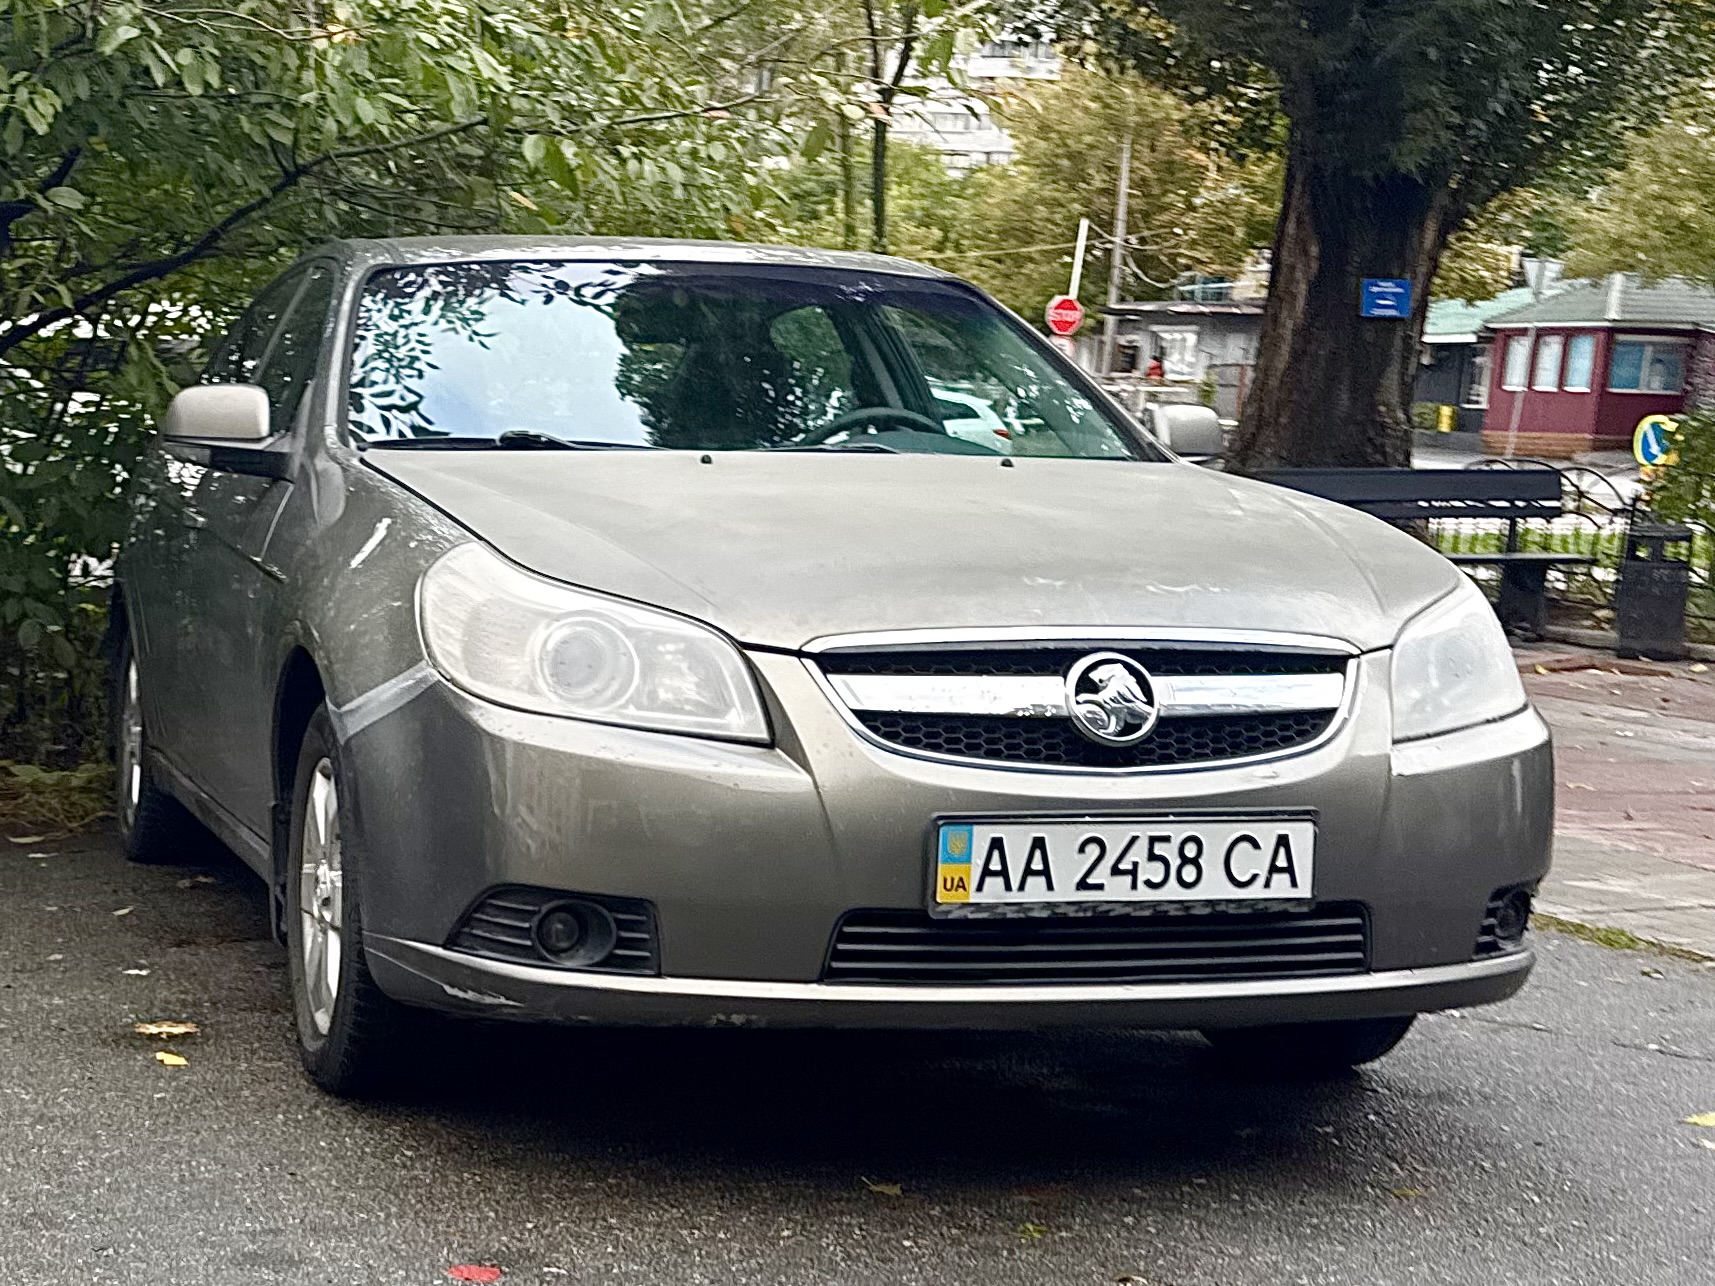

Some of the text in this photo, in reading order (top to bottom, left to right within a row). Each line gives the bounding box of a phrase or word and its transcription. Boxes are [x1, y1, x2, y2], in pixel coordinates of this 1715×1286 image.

[976, 833, 1299, 892] AA 2458 CA
[943, 878, 967, 892] UA
